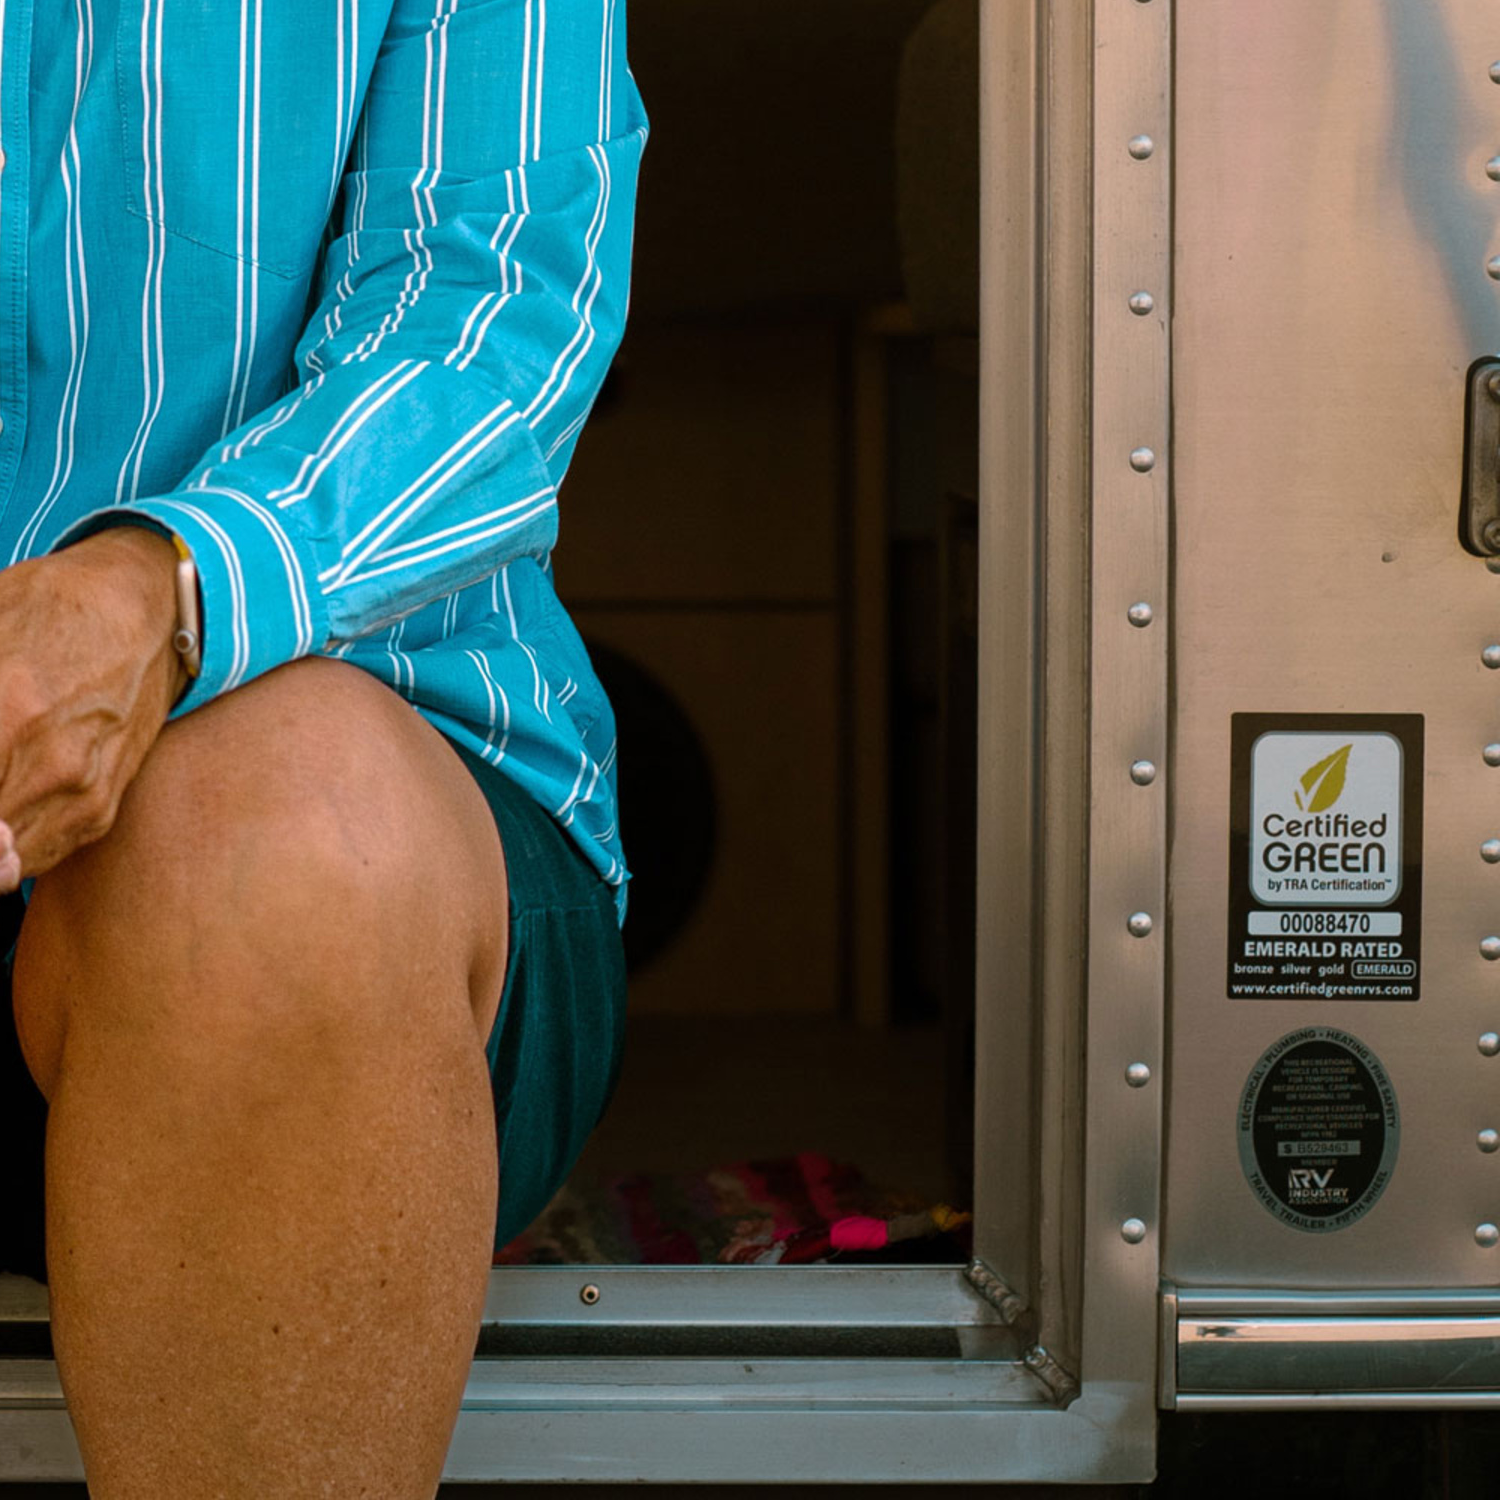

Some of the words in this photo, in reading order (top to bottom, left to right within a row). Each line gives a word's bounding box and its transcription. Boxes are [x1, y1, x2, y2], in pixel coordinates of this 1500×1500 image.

[1263, 814, 1387, 838] Certified
[1262, 842, 1385, 873] GREEN
[1268, 879, 1282, 892] by
[1284, 879, 1308, 890] TRA
[1280, 914, 1370, 933] 00088470
[1244, 941, 1336, 958] EMERALD
[1340, 942, 1402, 958] RATED
[1234, 962, 1274, 974] bronze
[1281, 963, 1312, 974] silver
[1318, 964, 1345, 977] gold
[1356, 964, 1412, 975] EMERALD
[1232, 982, 1413, 998] www.certifiedgreenrvs.com
[1242, 1071, 1265, 1132] ELECTRICAL
[1266, 1030, 1316, 1063] PLUMBING
[1326, 1031, 1369, 1058] HEATING
[1370, 1064, 1387, 1085] FIRE
[1383, 1088, 1396, 1129] SAFETY
[1288, 1168, 1334, 1188] RV
[1250, 1172, 1277, 1211] TRAVEL
[1279, 1209, 1325, 1229] TRAILER
[1336, 1204, 1364, 1225] FIFTH
[1363, 1170, 1388, 1204] WHEEL
[1289, 1188, 1349, 1198] INDUSTRY
